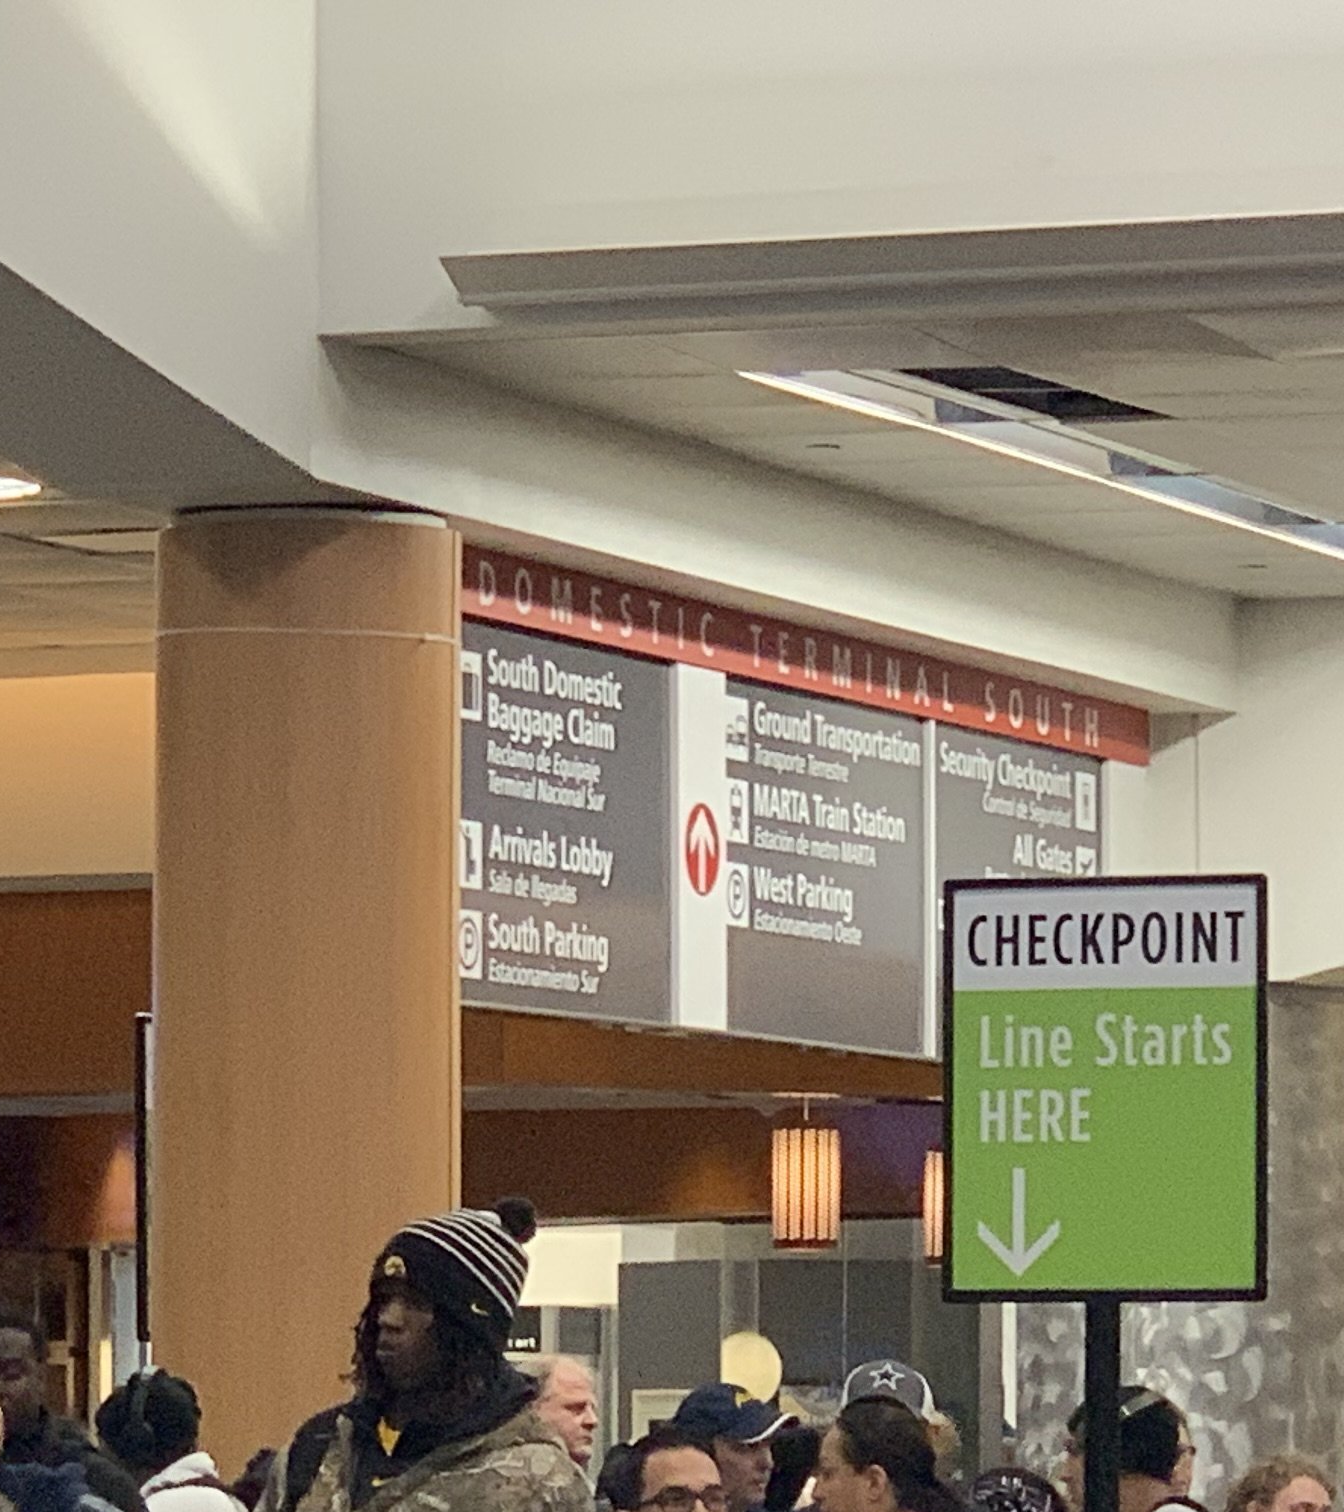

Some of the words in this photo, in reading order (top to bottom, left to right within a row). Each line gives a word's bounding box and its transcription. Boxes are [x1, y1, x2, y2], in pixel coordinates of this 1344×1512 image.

[479, 561, 715, 656] DOMESTIC
[750, 625, 954, 712] TERMINAL
[986, 682, 1101, 747] SOUTH
[487, 648, 539, 693] South
[544, 659, 623, 710] Domestic
[487, 693, 564, 749] Baggage
[567, 708, 615, 750] Claim
[754, 701, 811, 744] Ground
[814, 714, 921, 767] Transportation
[536, 749, 551, 774] de
[940, 741, 995, 790] Security
[997, 754, 1071, 800] Checkpoint
[587, 788, 605, 812] Sur
[754, 783, 810, 825] MARTA
[813, 794, 849, 832] Train
[853, 803, 905, 843] Station
[488, 824, 556, 869] Arrivals
[561, 836, 613, 887] Lobby
[796, 833, 809, 856] de
[841, 844, 876, 867] MARTA
[1013, 833, 1034, 867] All
[1036, 838, 1073, 874] Gates
[488, 869, 512, 894] Sala
[514, 873, 530, 898] de
[754, 866, 794, 905] West
[797, 873, 853, 922] Parking
[488, 913, 540, 955] South
[544, 921, 609, 973] Parking
[967, 911, 1245, 967] CHECKPOINT
[581, 970, 599, 994] Sur
[980, 1014, 1073, 1069] Line
[1095, 1012, 1233, 1067] Starts
[979, 1088, 1092, 1143] HERE
